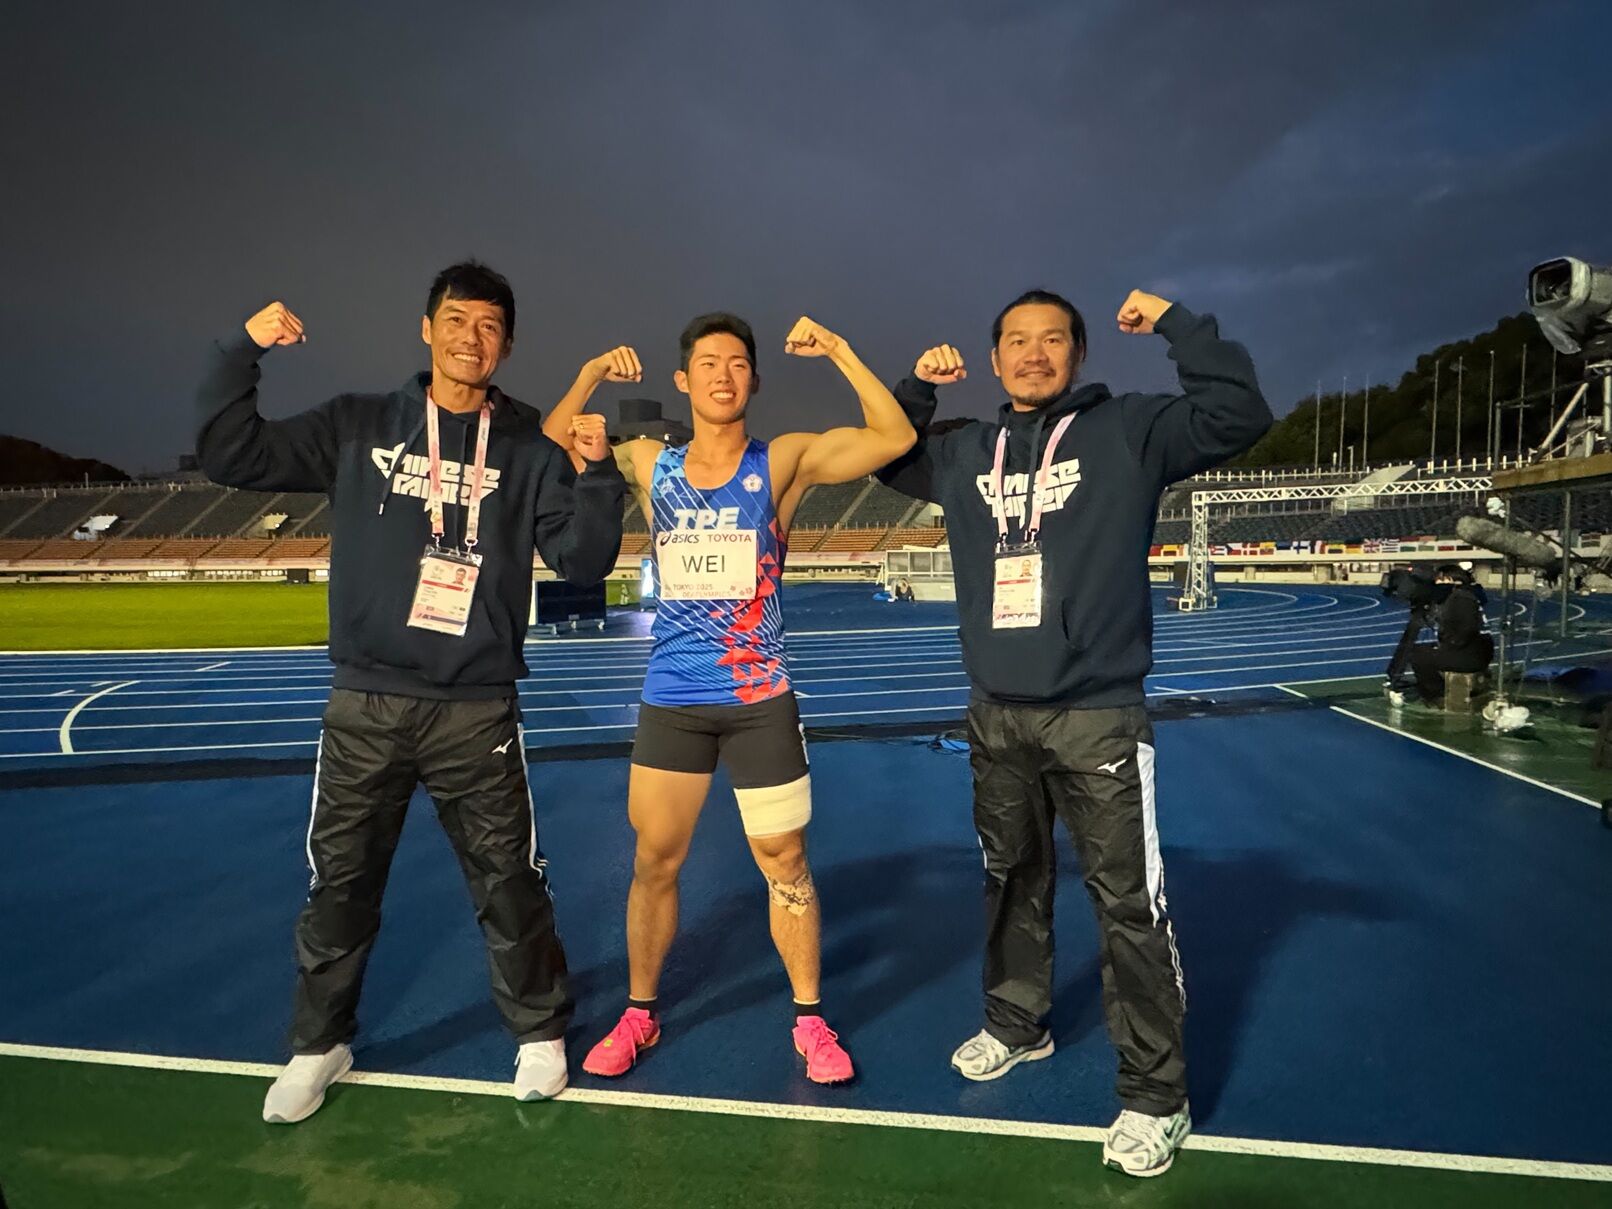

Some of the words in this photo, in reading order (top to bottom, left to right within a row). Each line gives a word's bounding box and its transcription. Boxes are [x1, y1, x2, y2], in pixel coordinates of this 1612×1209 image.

[674, 508, 740, 530] TPE
[671, 533, 700, 544] asics
[707, 534, 752, 543] TOYOTA
[682, 555, 726, 573] WEI
[673, 583, 694, 591] TOKYO
[695, 583, 713, 591] 2025
